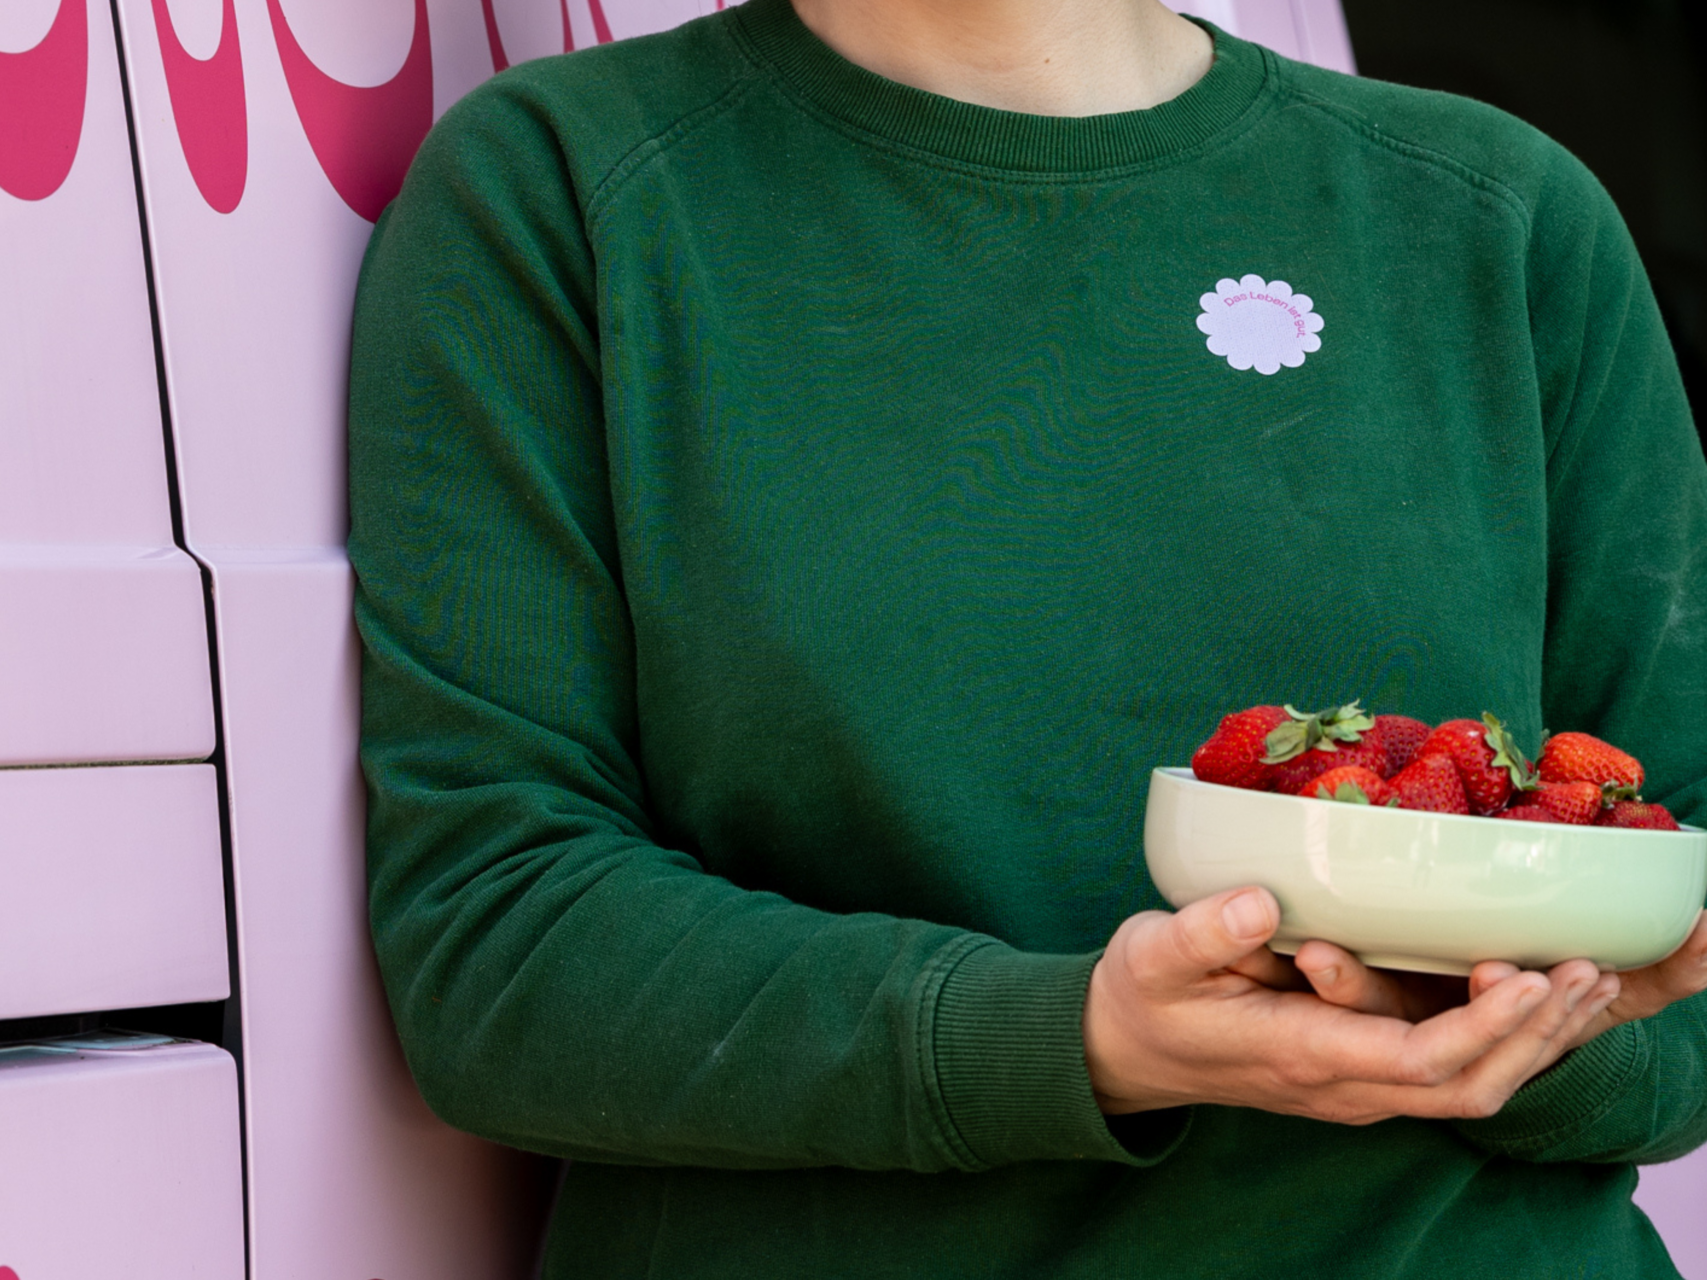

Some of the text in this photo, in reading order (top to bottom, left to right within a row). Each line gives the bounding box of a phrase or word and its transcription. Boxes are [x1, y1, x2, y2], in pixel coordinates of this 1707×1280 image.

[1224, 293, 1247, 307] Das
[1249, 291, 1288, 309] Leben
[1287, 306, 1301, 319] ist
